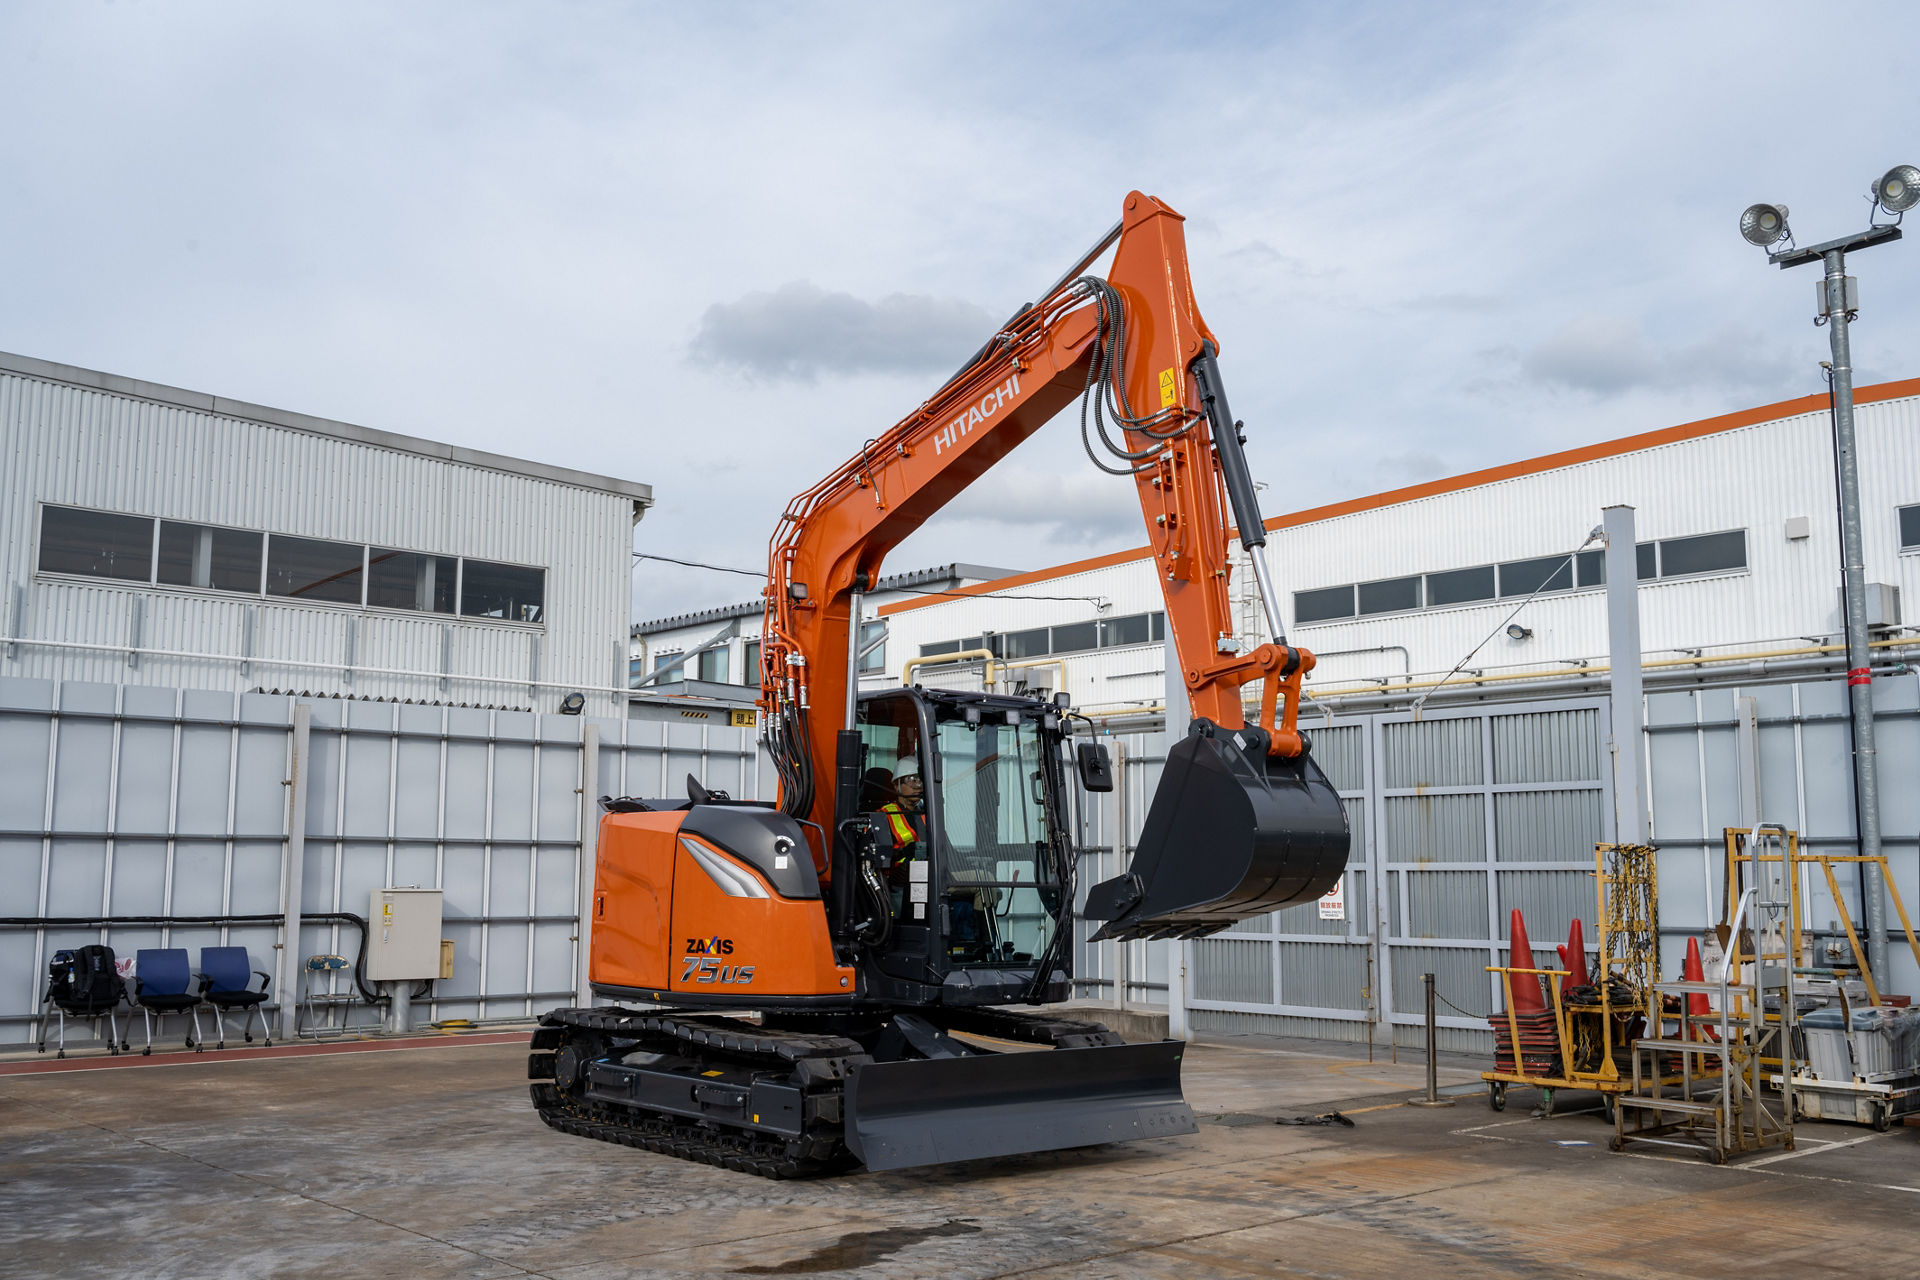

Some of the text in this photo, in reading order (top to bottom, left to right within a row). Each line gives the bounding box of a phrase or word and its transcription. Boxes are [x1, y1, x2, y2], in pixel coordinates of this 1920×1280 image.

[934, 374, 1020, 456] HITACHI
[736, 713, 757, 725] 頭上
[686, 936, 734, 954] ZAXIS
